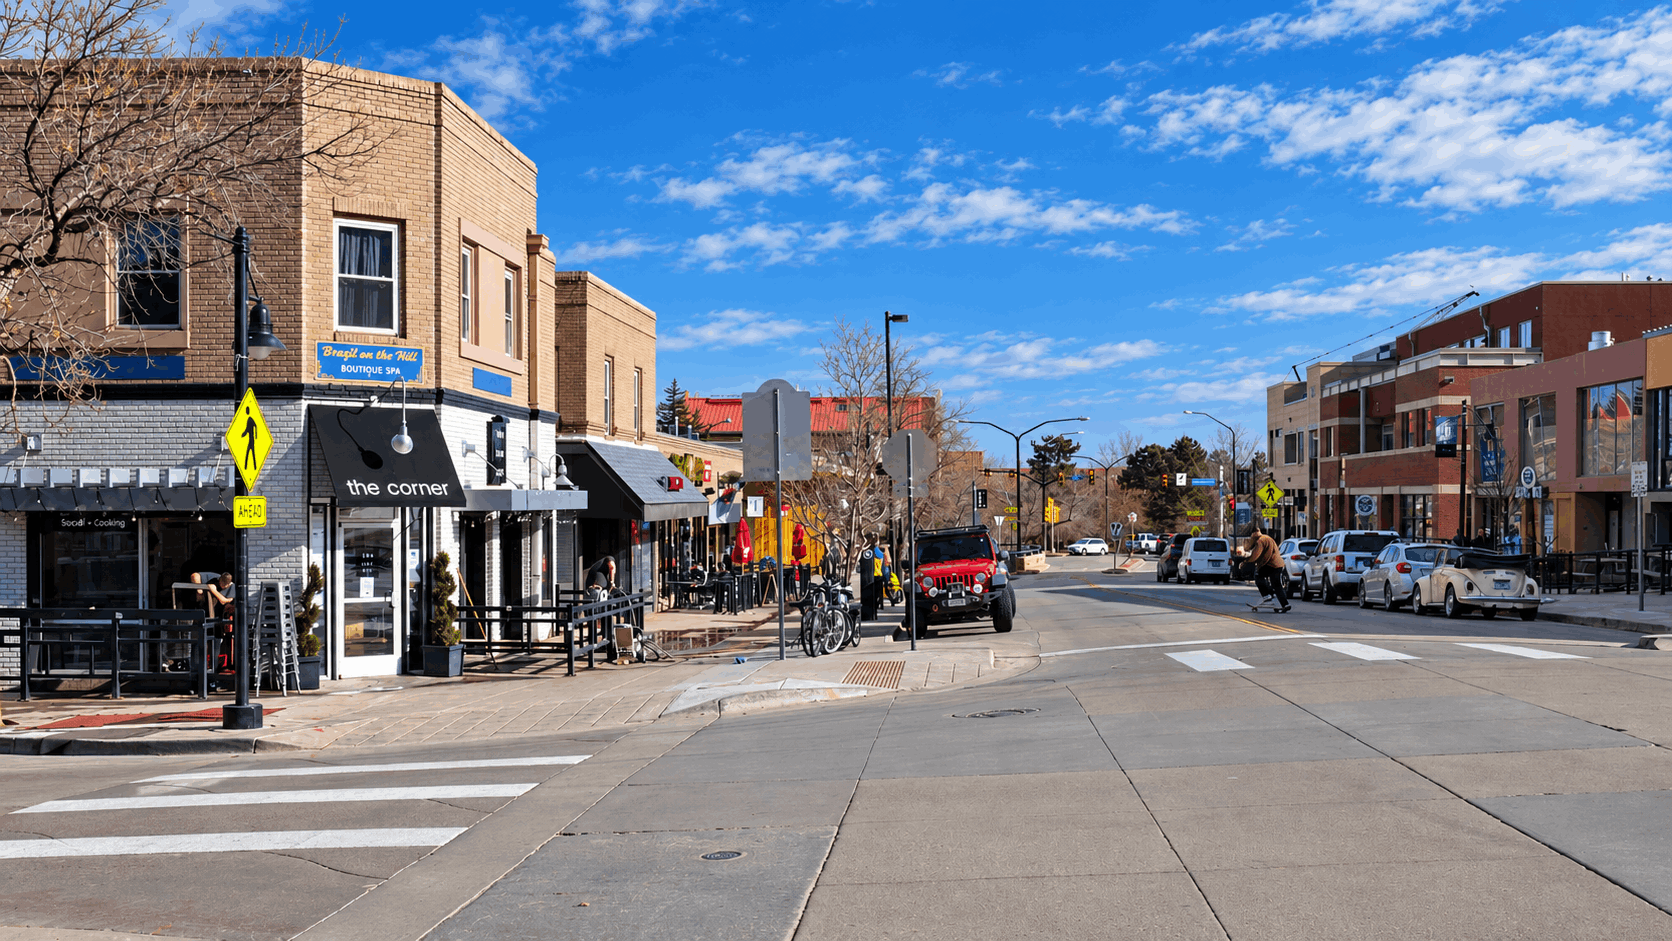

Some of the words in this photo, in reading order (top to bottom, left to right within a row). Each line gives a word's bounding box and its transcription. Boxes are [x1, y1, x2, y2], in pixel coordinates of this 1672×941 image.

[322, 345, 358, 361] Brazil
[359, 350, 374, 360] on
[376, 349, 393, 360] the
[395, 350, 419, 362] Hill
[341, 364, 383, 378] BOUTIQUE
[385, 366, 401, 375] SPA
[346, 479, 381, 496] the
[387, 482, 449, 496] corner
[238, 504, 262, 518] AHEAD
